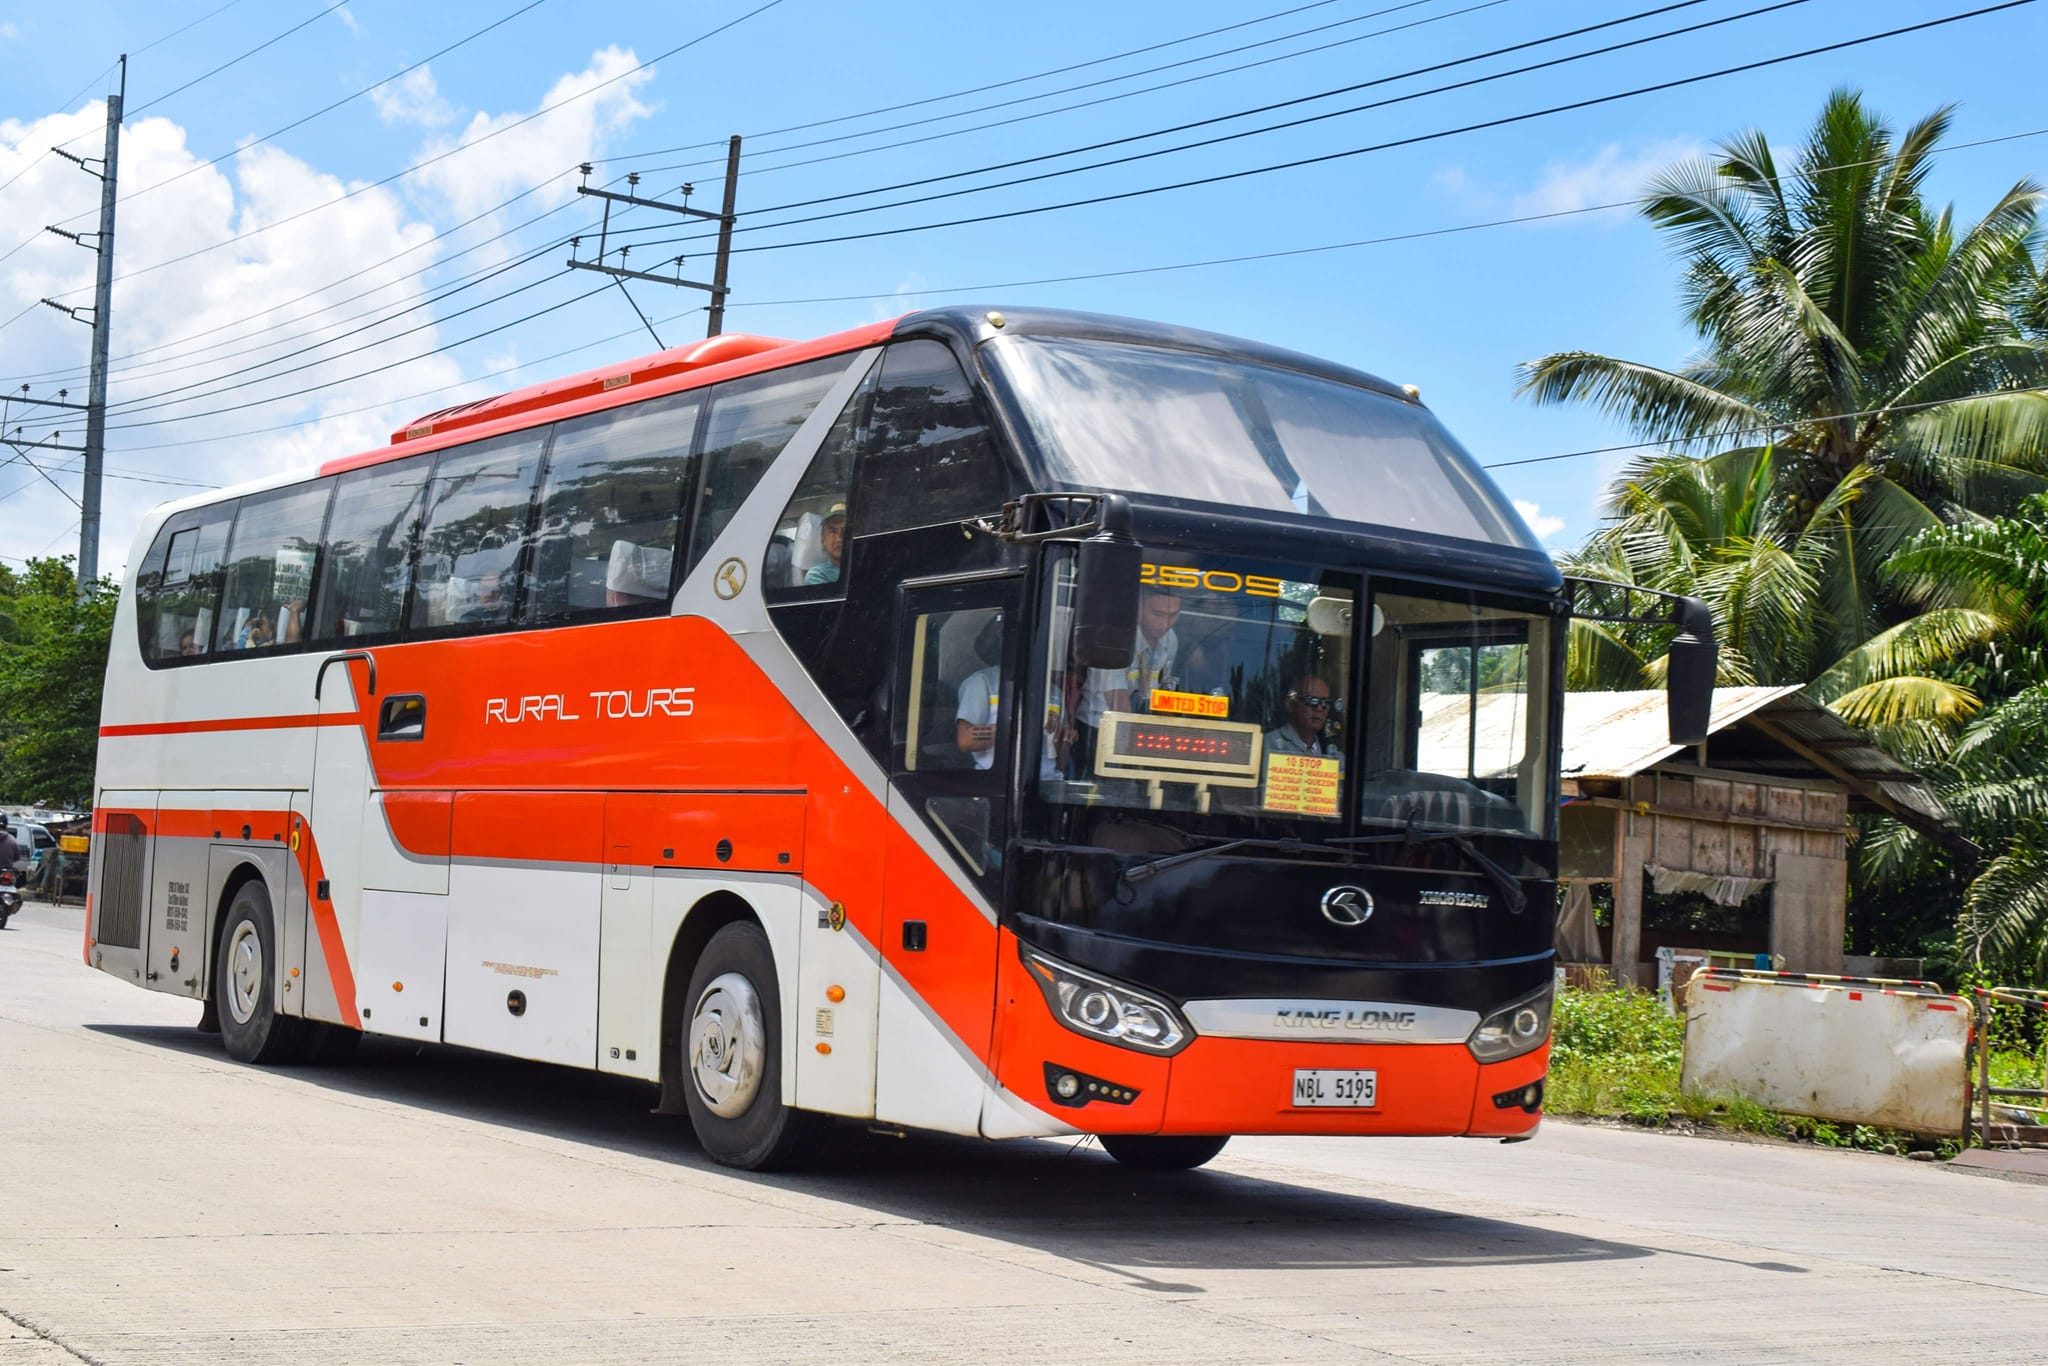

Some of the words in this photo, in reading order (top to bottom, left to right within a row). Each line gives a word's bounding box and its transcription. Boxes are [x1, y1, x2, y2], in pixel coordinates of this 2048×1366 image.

[485, 694, 580, 725] RURAL
[589, 687, 696, 719] TOURS
[1151, 693, 1195, 712] LIMITED
[1199, 696, 1227, 715] STOP
[1286, 756, 1296, 767] 10
[1299, 758, 1322, 769] STOP
[1273, 1010, 1341, 1029] KING
[1344, 1011, 1416, 1031] LONG
[1295, 1078, 1325, 1099] NBL
[1335, 1078, 1374, 1099] 5195
